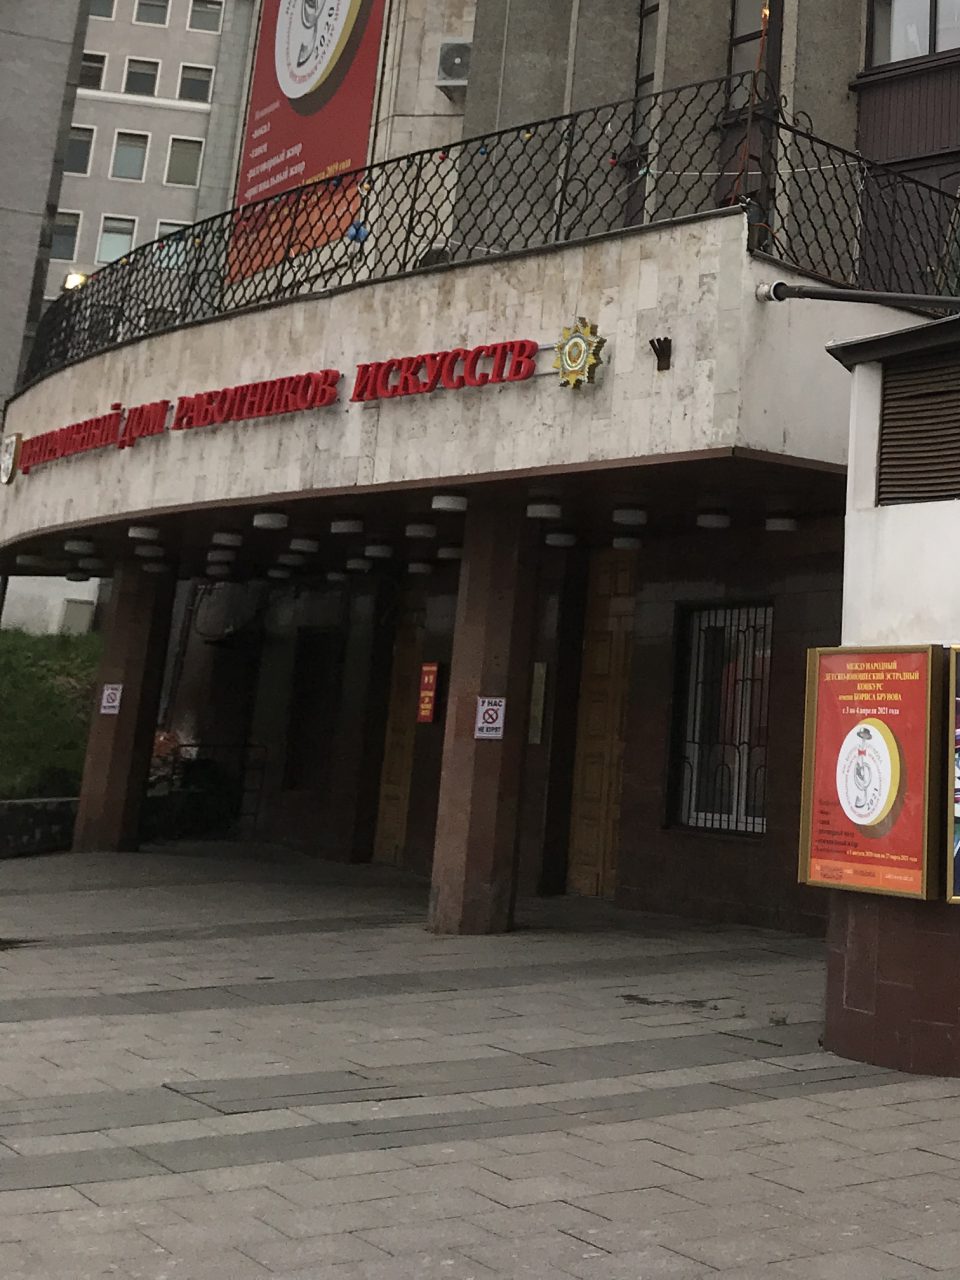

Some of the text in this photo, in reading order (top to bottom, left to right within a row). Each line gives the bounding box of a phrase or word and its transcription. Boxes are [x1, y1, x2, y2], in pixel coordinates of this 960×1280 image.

[117, 399, 171, 449] ДОМ
[171, 369, 340, 430] РАБОТНИКОВ
[349, 339, 539, 402] ИСКУССТВ
[846, 660, 897, 671] МЕЖДУНАРОДНЫЙ
[886, 671, 919, 681] ЭСТРАДНЫЙ
[857, 683, 884, 691] КОНКУРС
[854, 693, 876, 701] БОРИСА
[877, 693, 902, 701] БРУНОВА
[860, 708, 877, 716] апреля
